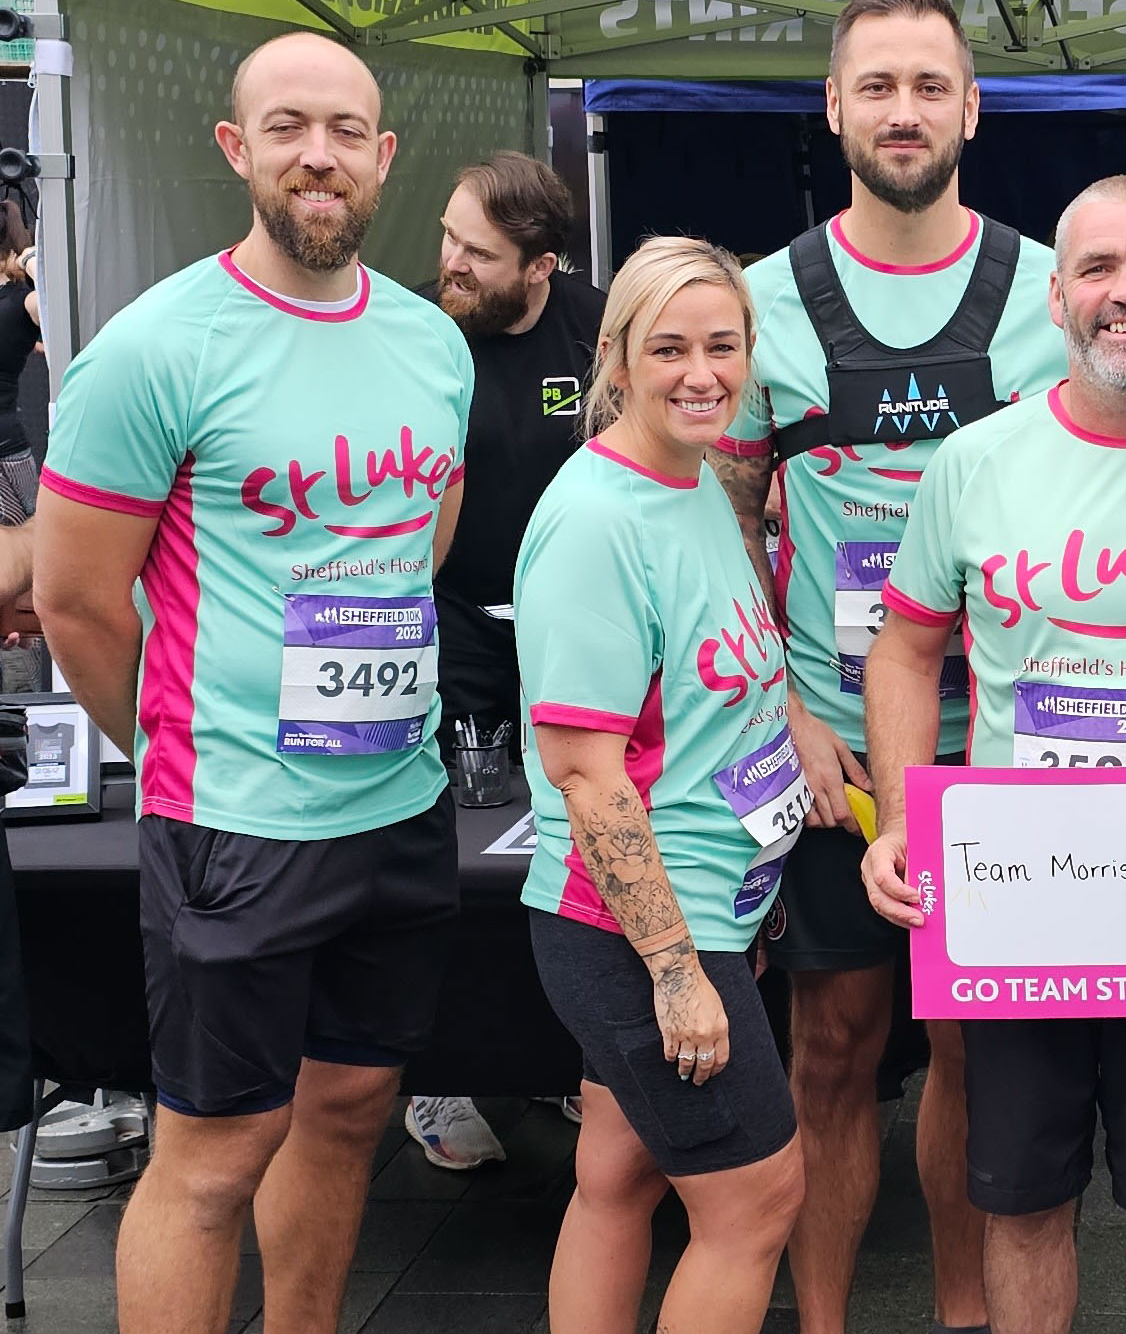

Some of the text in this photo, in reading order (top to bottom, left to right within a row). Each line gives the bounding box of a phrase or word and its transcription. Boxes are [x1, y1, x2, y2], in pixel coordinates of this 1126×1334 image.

[542, 387, 562, 401] PB
[878, 398, 950, 415] RUNITUDE
[335, 425, 454, 507] Luke
[842, 501, 910, 521] Sheffiel
[291, 558, 386, 582] Sheffield's
[981, 549, 1052, 629] St
[341, 609, 421, 623] SHEFFIELD 10K
[395, 626, 423, 641] 2023
[1023, 657, 1114, 677] Sheffield's
[316, 660, 418, 698] 3492
[325, 739, 342, 748] ALL
[951, 841, 1032, 883] Team
[950, 977, 999, 1003] GO
[1004, 977, 1088, 1003] TEAM
